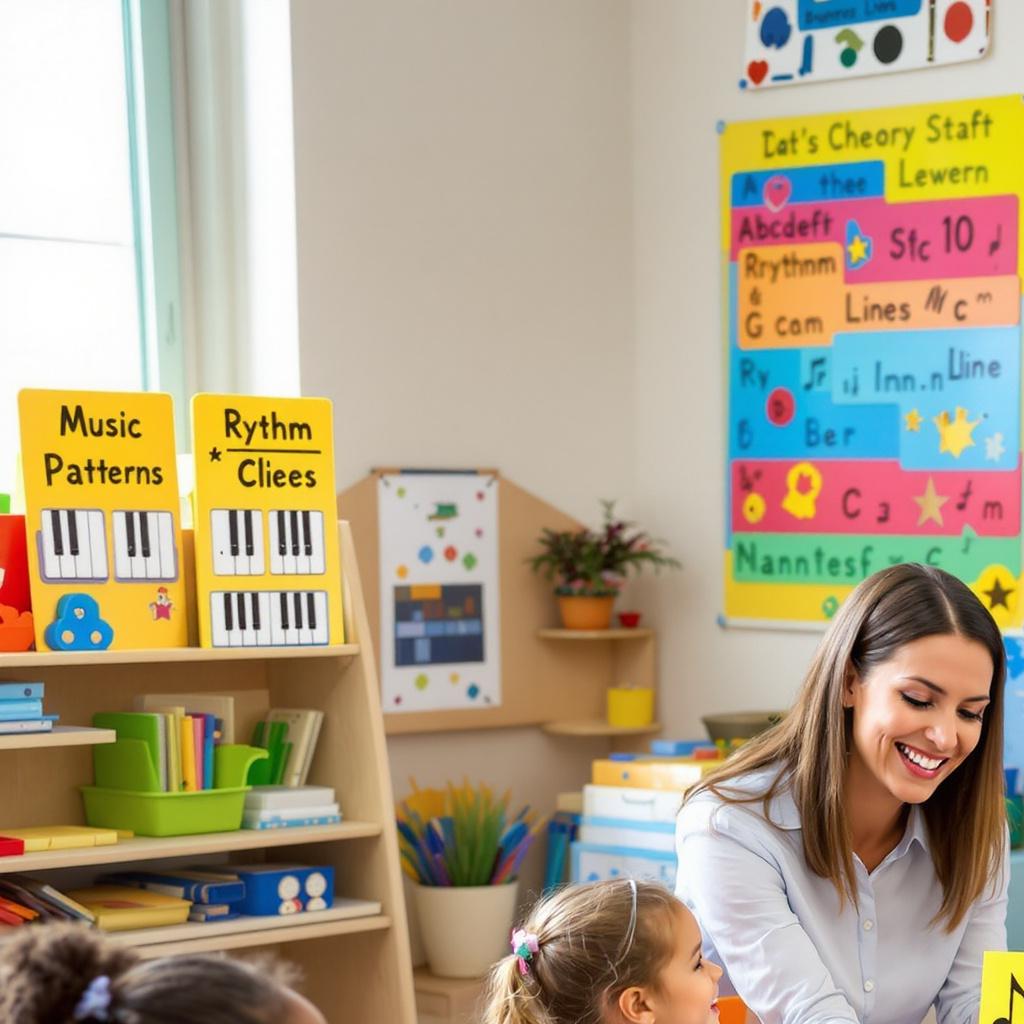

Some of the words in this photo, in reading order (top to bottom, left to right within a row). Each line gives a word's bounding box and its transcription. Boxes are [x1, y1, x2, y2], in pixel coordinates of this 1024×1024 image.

[828, 121, 915, 152] Cheory
[926, 110, 993, 144] Staff
[899, 159, 988, 188] Lewern
[943, 215, 975, 254] 10
[745, 312, 763, 339] G
[845, 292, 911, 324] Lines
[60, 404, 142, 439] Music
[224, 407, 313, 446] Rythm
[44, 452, 164, 487] Patterns
[237, 457, 318, 488] Cliees
